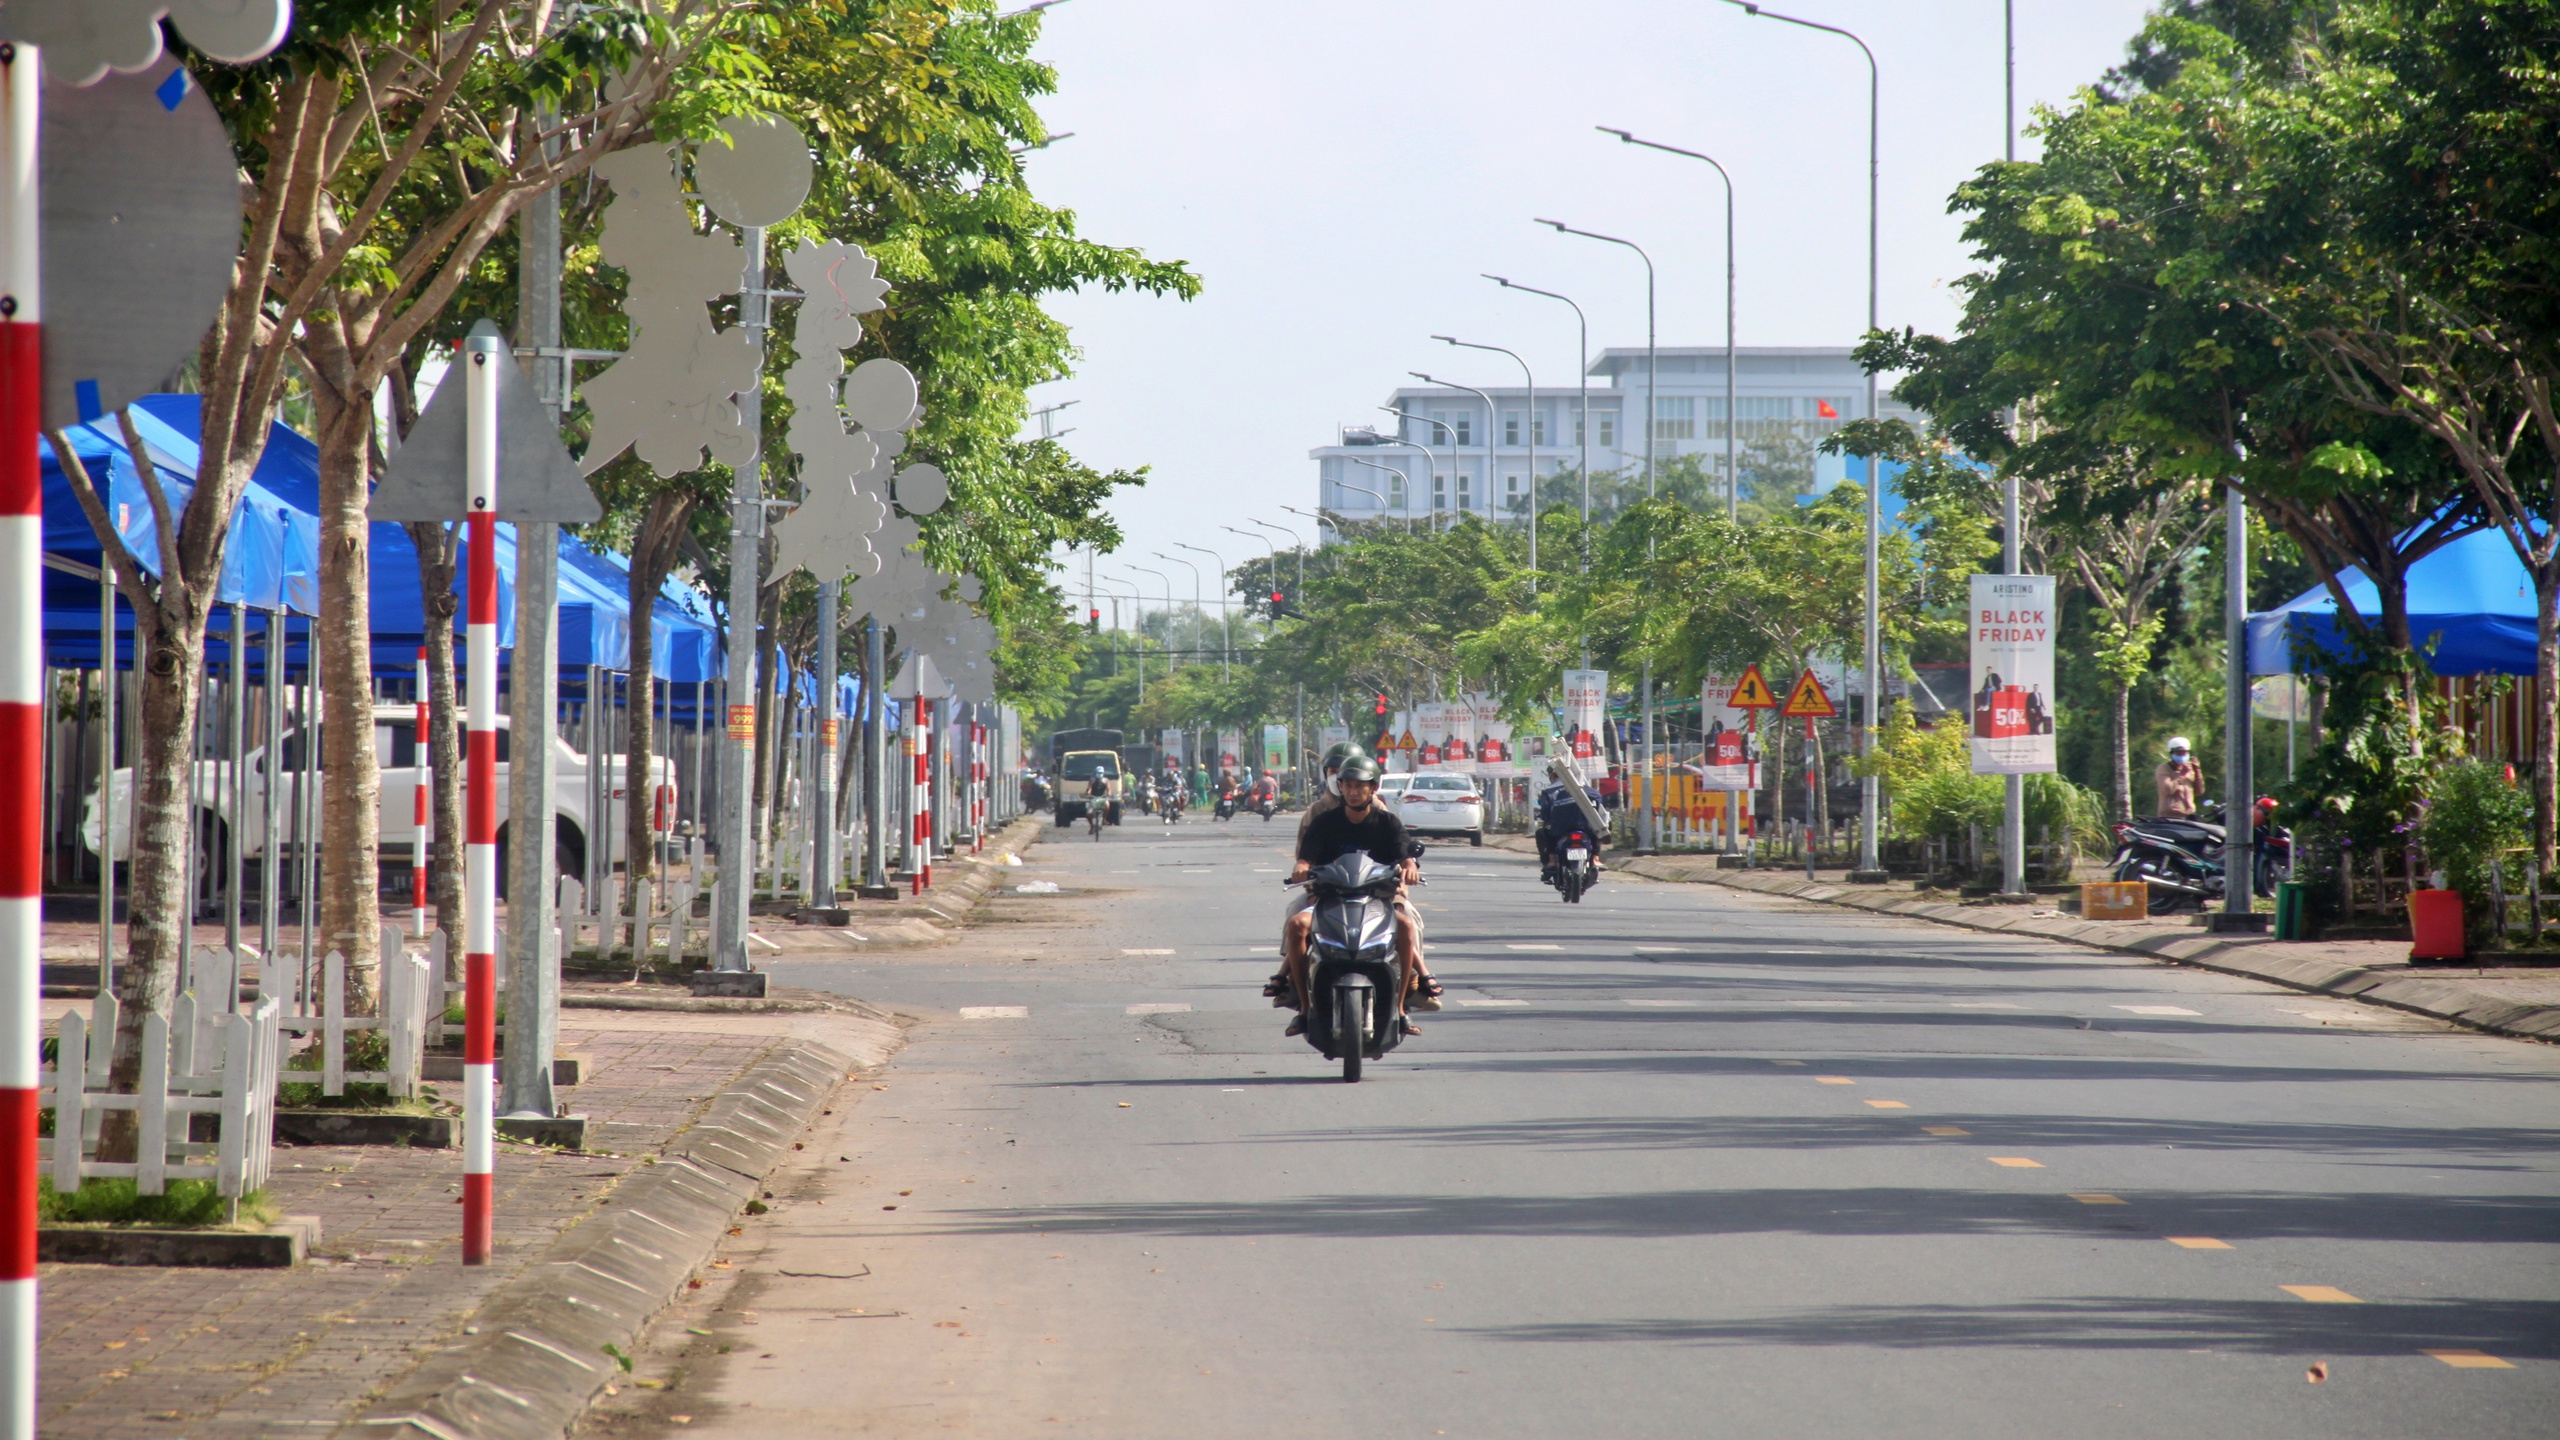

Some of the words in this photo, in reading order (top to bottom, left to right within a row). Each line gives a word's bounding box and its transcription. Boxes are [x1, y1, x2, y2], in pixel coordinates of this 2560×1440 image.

[1993, 585, 2034, 594] ARISTINO
[1982, 610, 2044, 624] BLACK
[1979, 629, 2046, 642] FRIDAY
[1568, 689, 1601, 697] BLACK
[734, 714, 752, 724] 999
[1996, 708, 2026, 726] 50%
[1719, 745, 1742, 758] 50%
